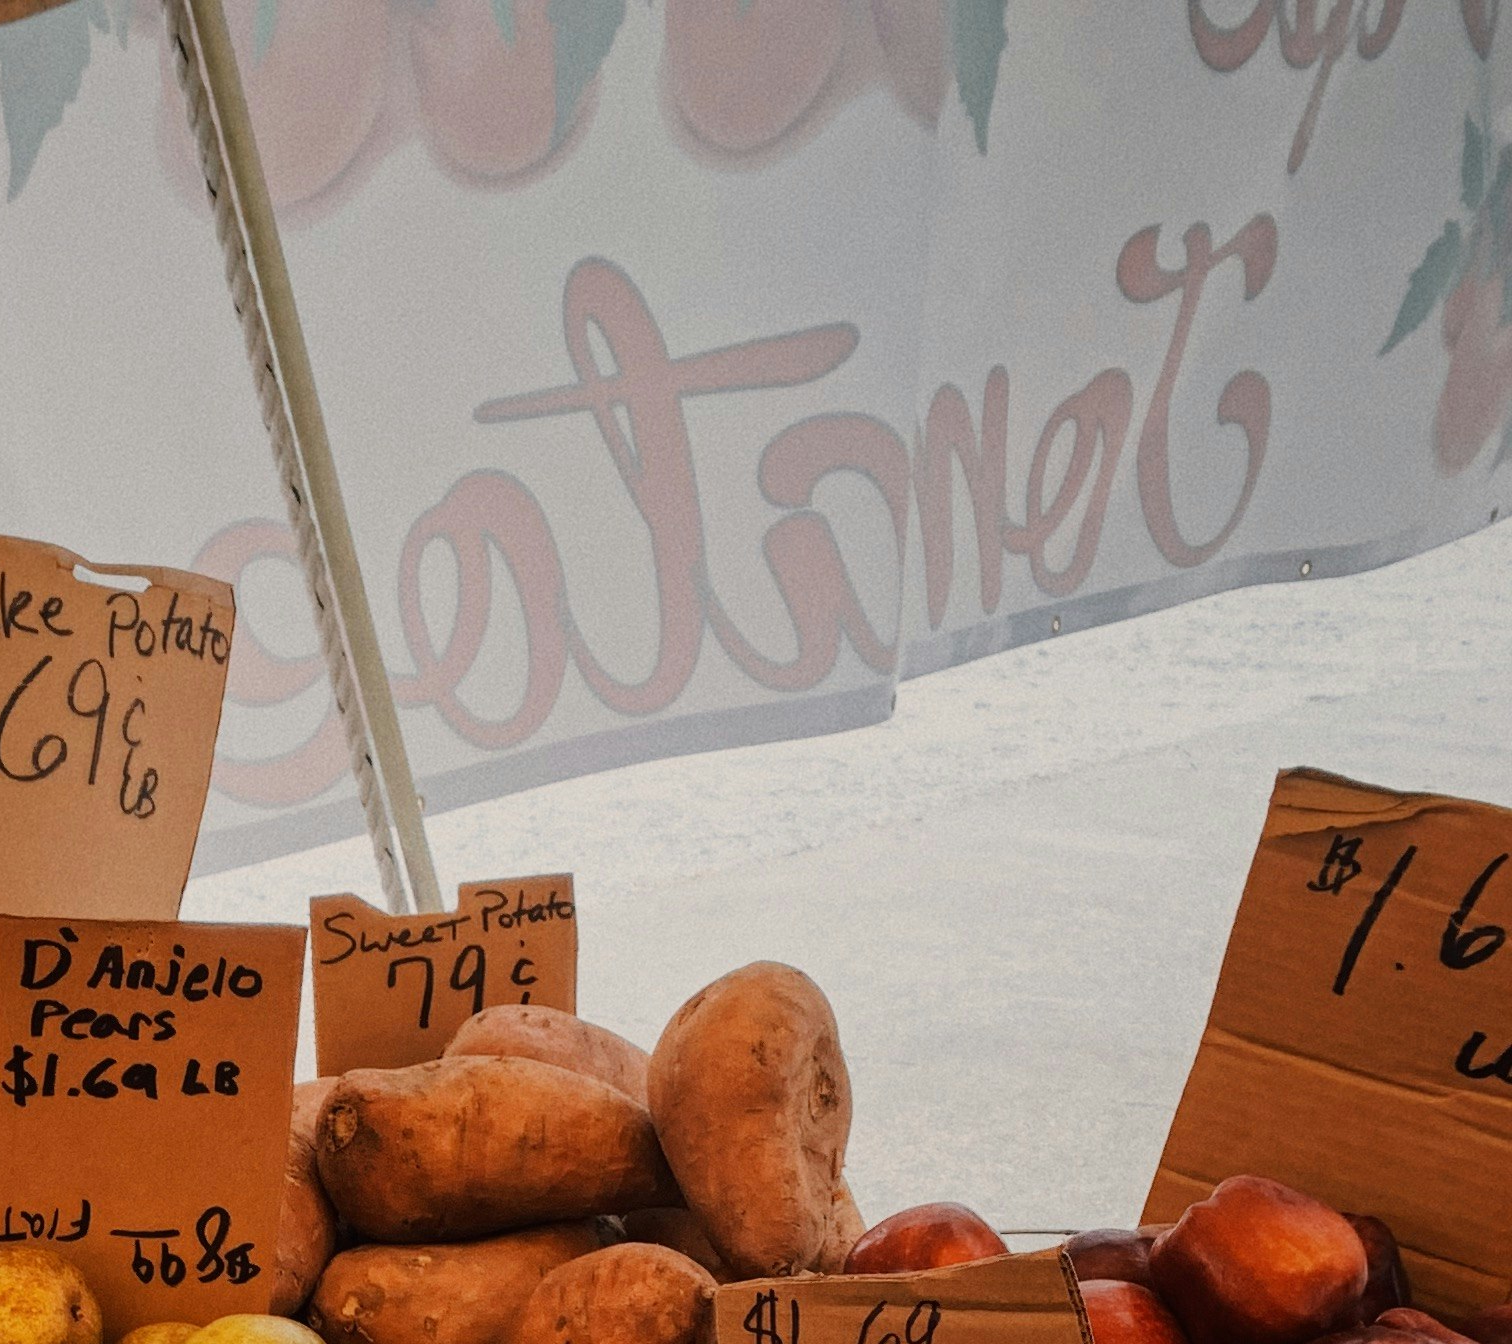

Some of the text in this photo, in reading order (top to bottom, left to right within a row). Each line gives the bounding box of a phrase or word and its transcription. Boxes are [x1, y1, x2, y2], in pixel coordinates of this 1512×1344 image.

[106, 591, 234, 665] Potato
[475, 889, 574, 932] Potato
[1306, 833, 1510, 996] $1.6
[30, 998, 177, 1042] Pears
[2, 1044, 240, 1108] $1.69 LB
